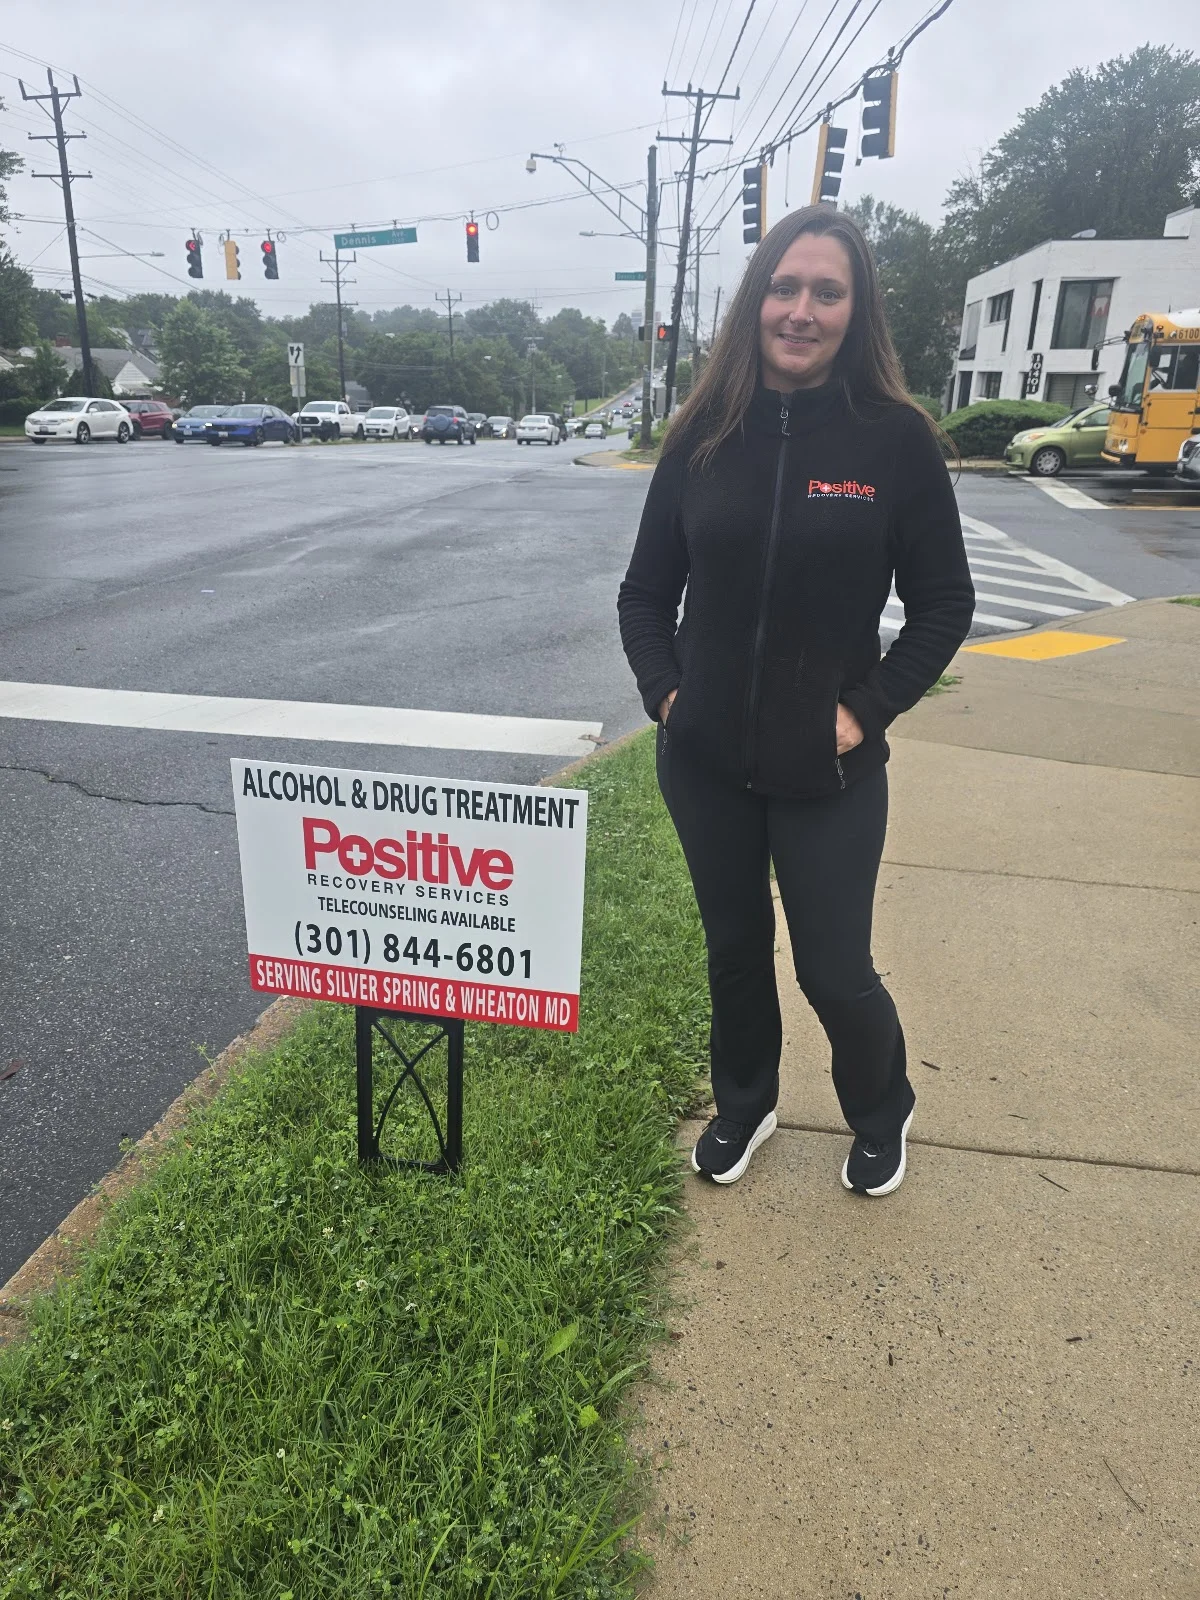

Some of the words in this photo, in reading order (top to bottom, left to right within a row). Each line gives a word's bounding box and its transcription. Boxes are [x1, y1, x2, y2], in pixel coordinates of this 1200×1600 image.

[341, 235, 377, 247] Dennis
[808, 480, 876, 497] Positive
[845, 493, 874, 502] SERVICES
[242, 767, 347, 807] ALCOHOL
[351, 778, 368, 810] &
[372, 780, 438, 817] DRUG
[441, 787, 580, 829] TREATMENT
[302, 816, 514, 891] Positive
[307, 873, 406, 896] RECOVERY
[415, 885, 509, 907] SERVICES
[317, 896, 438, 924] TELECOUNSELING
[440, 910, 516, 933] AVAILABLE
[294, 920, 371, 965] (301)
[383, 933, 532, 979] 844-6801
[256, 959, 322, 995] SERVING
[326, 969, 379, 1002] SILVER
[382, 976, 440, 1010] SPRING
[445, 984, 456, 1012] &
[460, 986, 539, 1022] WHEATON
[544, 996, 571, 1026] MD
